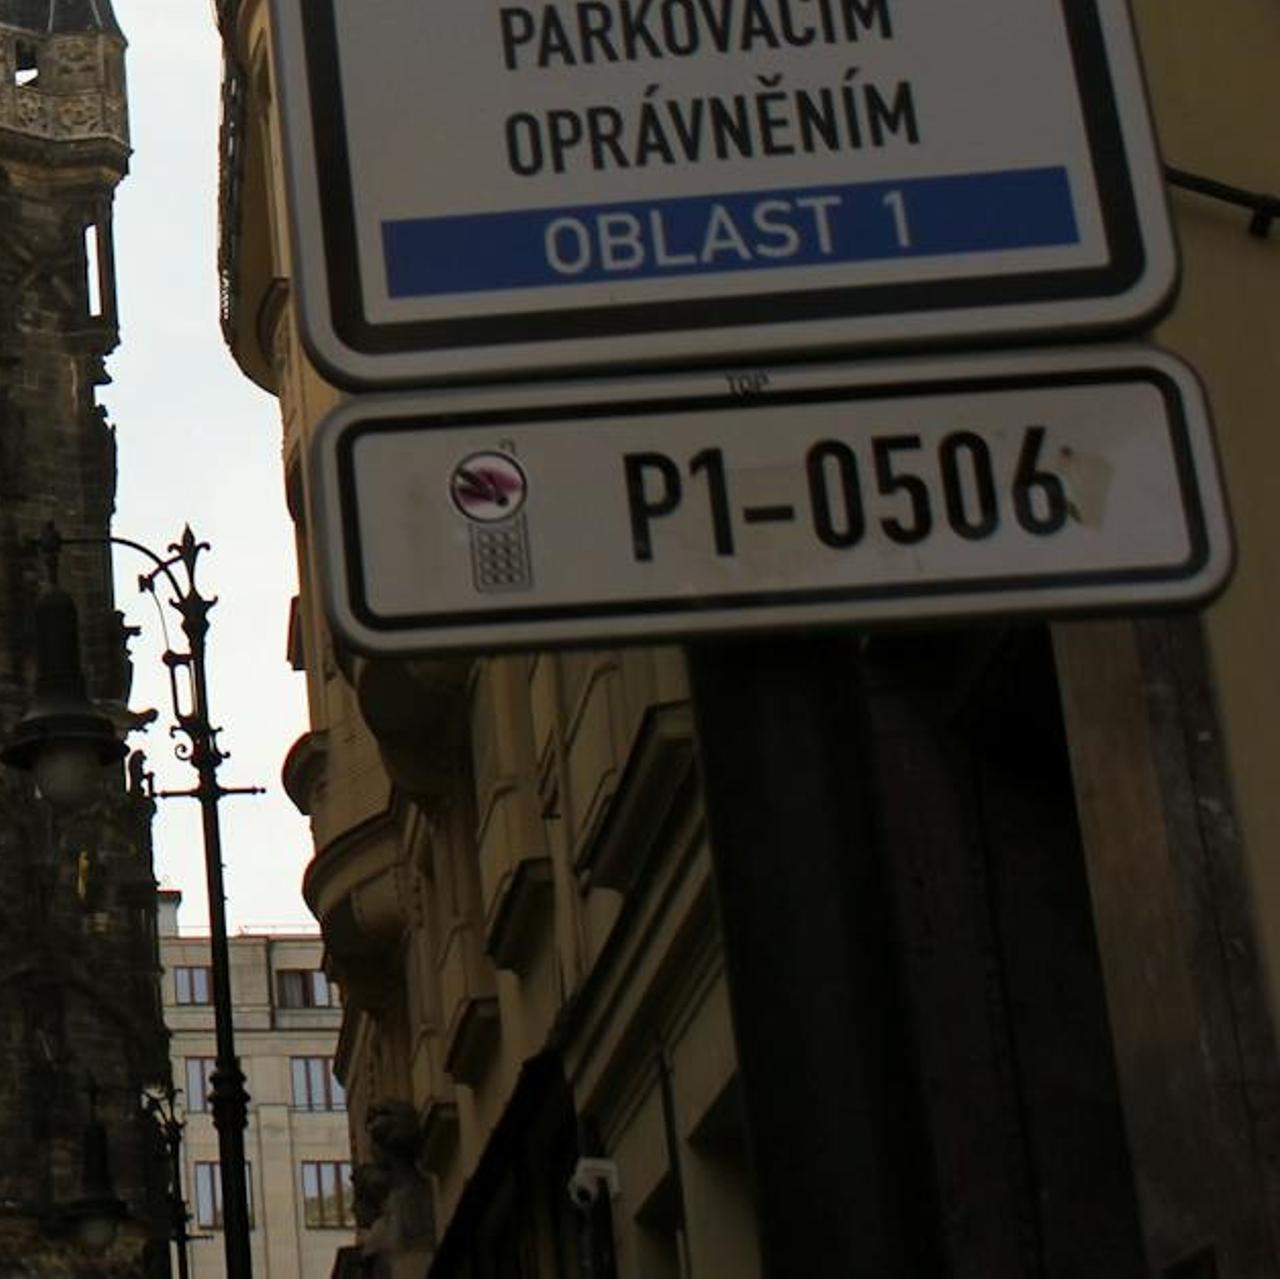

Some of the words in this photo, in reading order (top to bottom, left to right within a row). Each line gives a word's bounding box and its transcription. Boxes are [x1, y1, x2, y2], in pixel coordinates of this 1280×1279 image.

[505, 73, 921, 177] OPRÁVNĚNÍM
[545, 195, 842, 275] OBLAST
[883, 190, 911, 249] 1
[623, 426, 1068, 563] P1-0506
